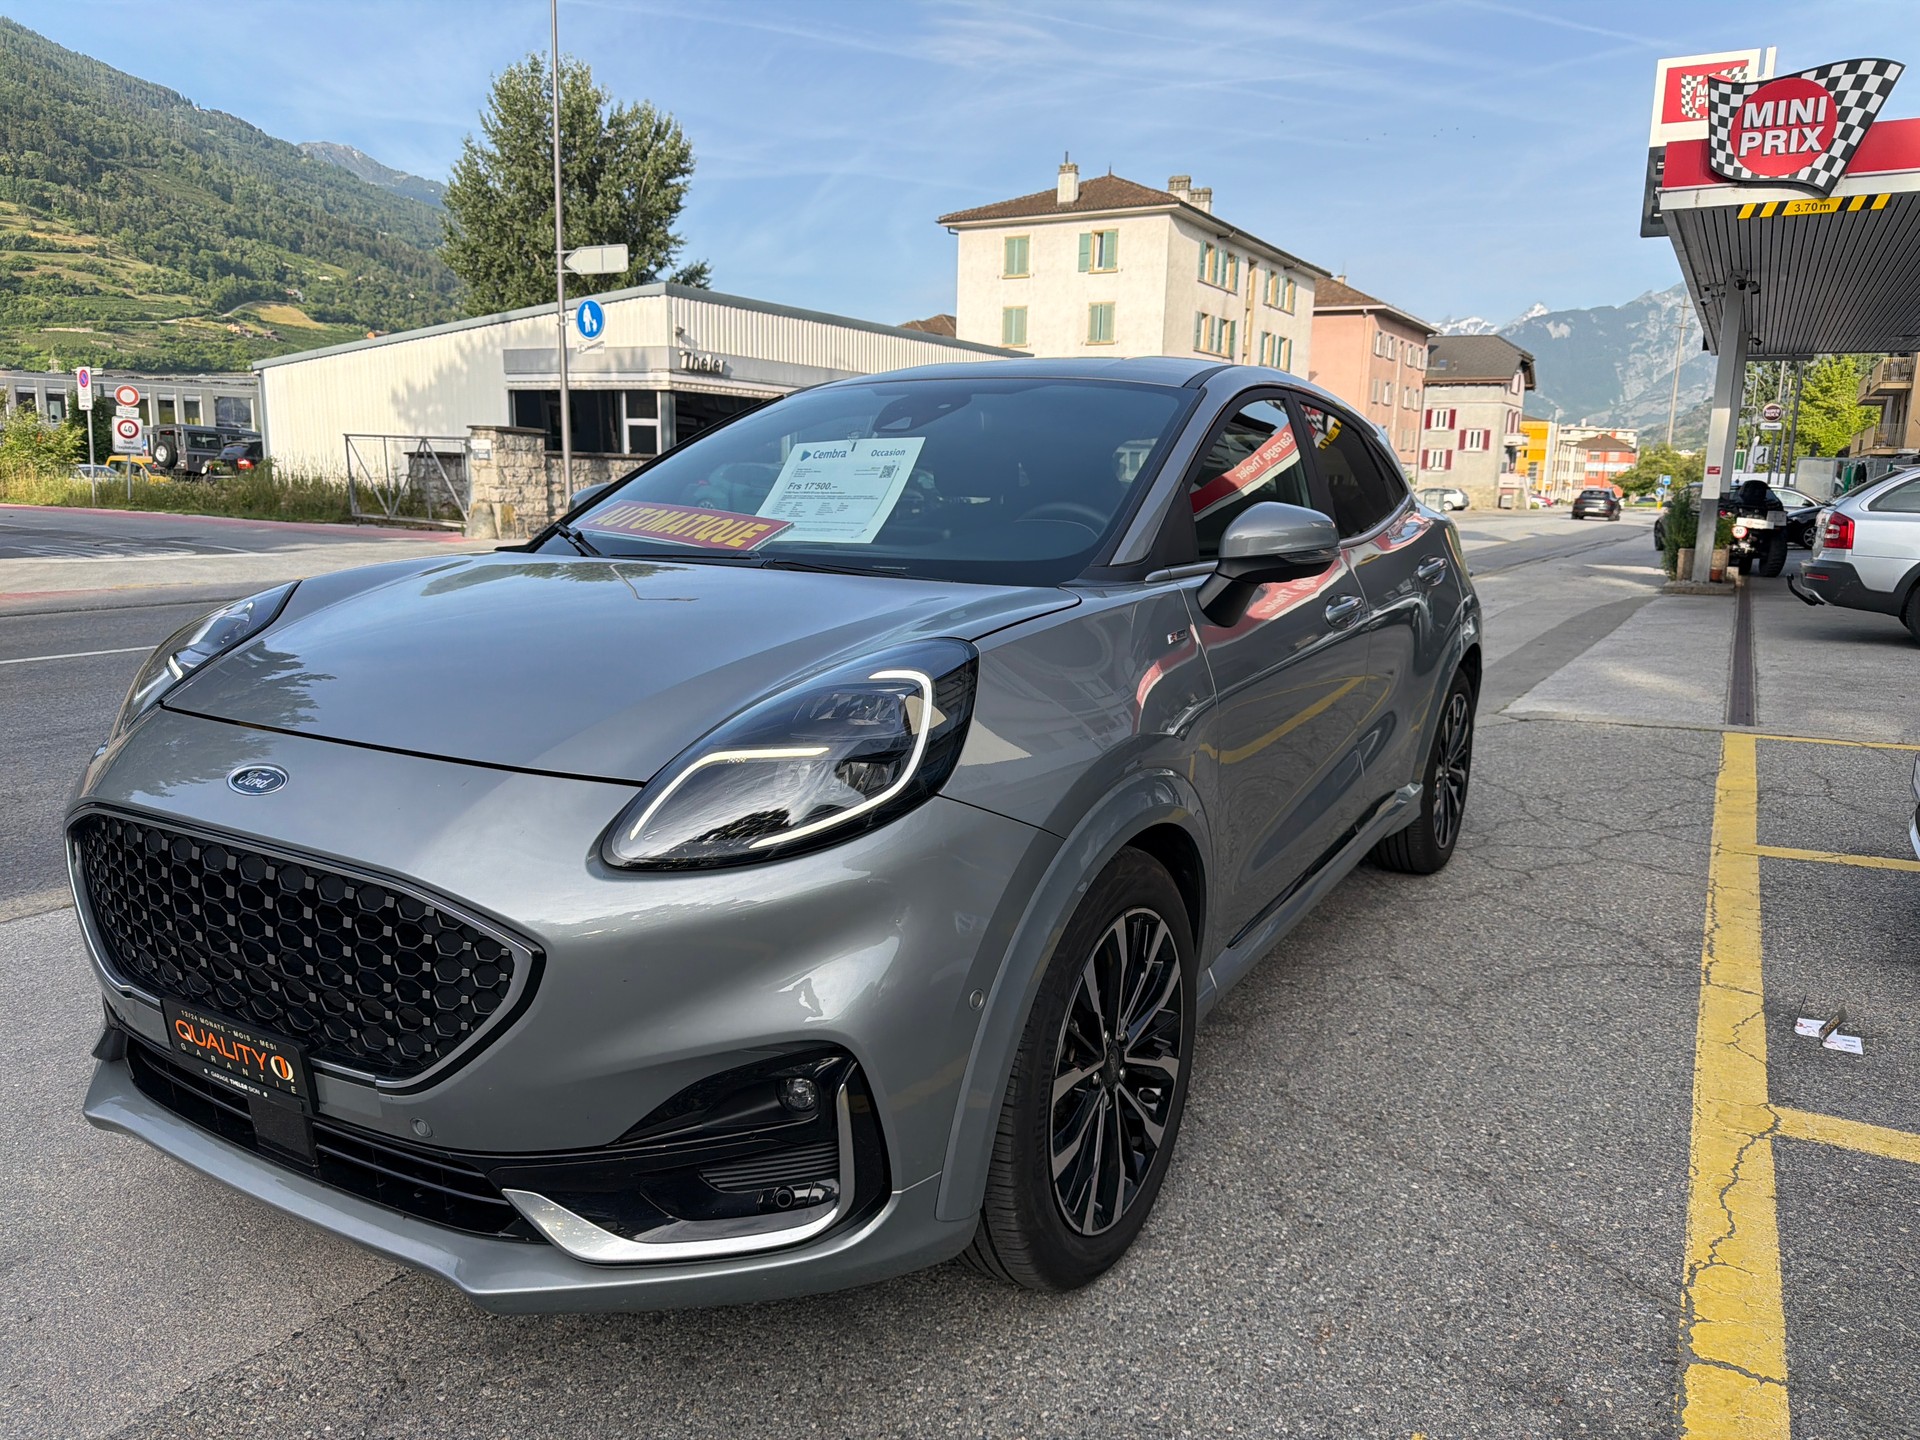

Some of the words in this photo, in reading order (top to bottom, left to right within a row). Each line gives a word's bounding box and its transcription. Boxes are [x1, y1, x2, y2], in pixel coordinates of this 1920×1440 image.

[1741, 95, 1828, 130] MINI
[1738, 126, 1826, 159] PRIX
[679, 350, 726, 373] Theler
[123, 425, 133, 433] 40
[812, 449, 847, 459] Cembra
[870, 448, 906, 457] Occasion
[787, 482, 802, 490] Frs
[589, 506, 771, 548] AUTOMATIQUE
[237, 770, 275, 789] Ford
[181, 1010, 198, 1021] 12/24
[199, 1017, 226, 1033] MONATE
[233, 1030, 251, 1042] MOIS
[259, 1039, 278, 1051] MESI
[175, 1019, 267, 1071] QUALITY
[180, 1042, 297, 1095] GARANTIE
